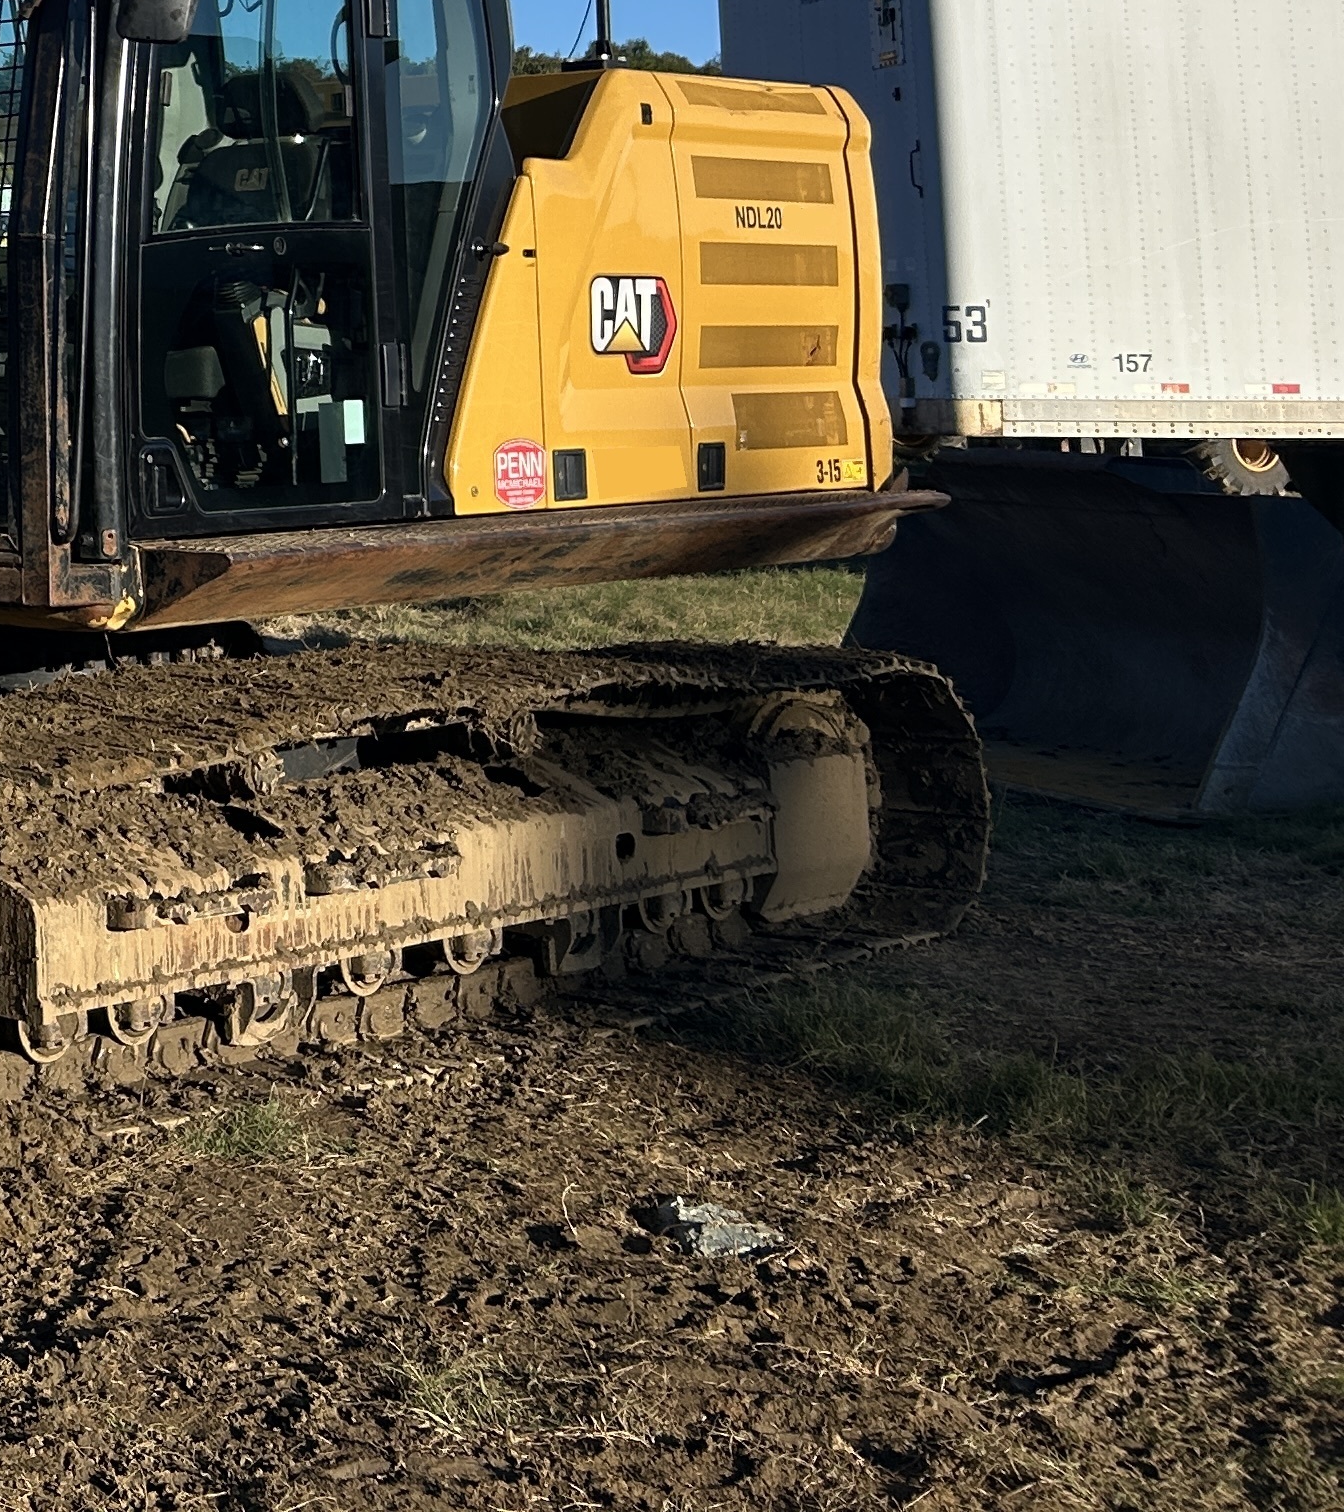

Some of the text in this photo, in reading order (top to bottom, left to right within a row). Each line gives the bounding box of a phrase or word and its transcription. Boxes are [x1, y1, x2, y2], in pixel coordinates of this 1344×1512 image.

[235, 168, 269, 191] CAT
[735, 206, 782, 229] NDL20
[591, 277, 657, 352] CAT
[1114, 354, 1152, 372] 157
[497, 452, 543, 479] PENN
[816, 459, 841, 484] 3-15
